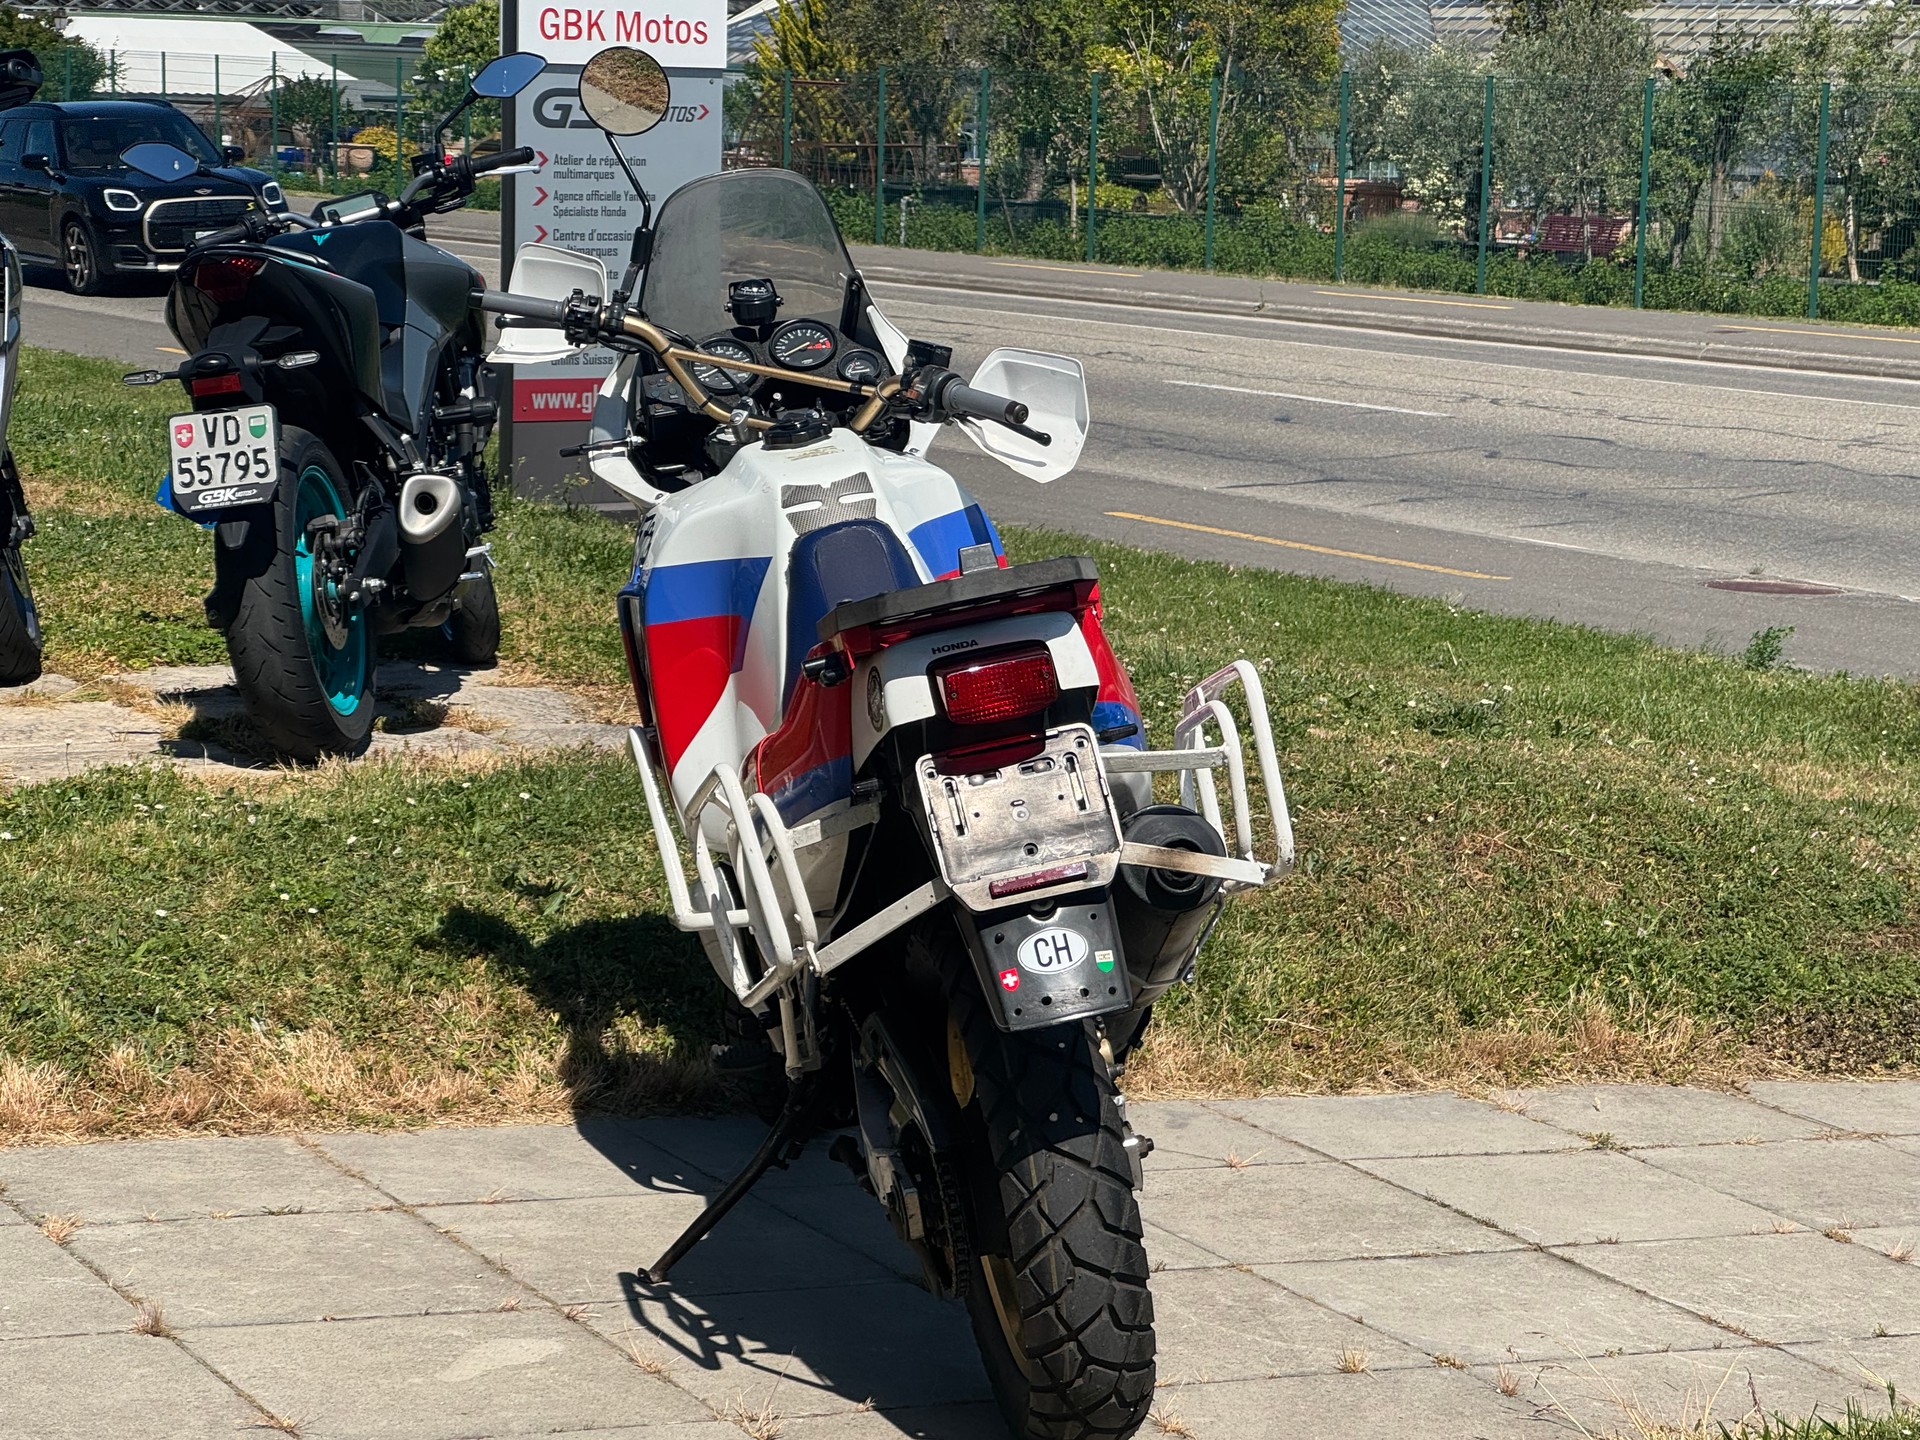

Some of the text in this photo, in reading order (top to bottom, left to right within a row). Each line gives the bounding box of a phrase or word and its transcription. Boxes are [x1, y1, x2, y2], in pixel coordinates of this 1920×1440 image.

[540, 8, 709, 45] GBK Motos
[553, 153, 584, 166] Atelier
[586, 154, 597, 166] de
[553, 168, 615, 182] multimarques
[553, 190, 584, 204] Agence
[586, 190, 622, 202] officielle
[553, 205, 627, 219] Spécialiste Honda
[553, 228, 635, 242] Centre d'occasio
[583, 352, 614, 366] Suisse
[202, 415, 241, 448] VD
[177, 447, 271, 489] 55795
[197, 487, 239, 504] GBK
[931, 639, 979, 655] HONDA
[1033, 932, 1073, 968] CH
